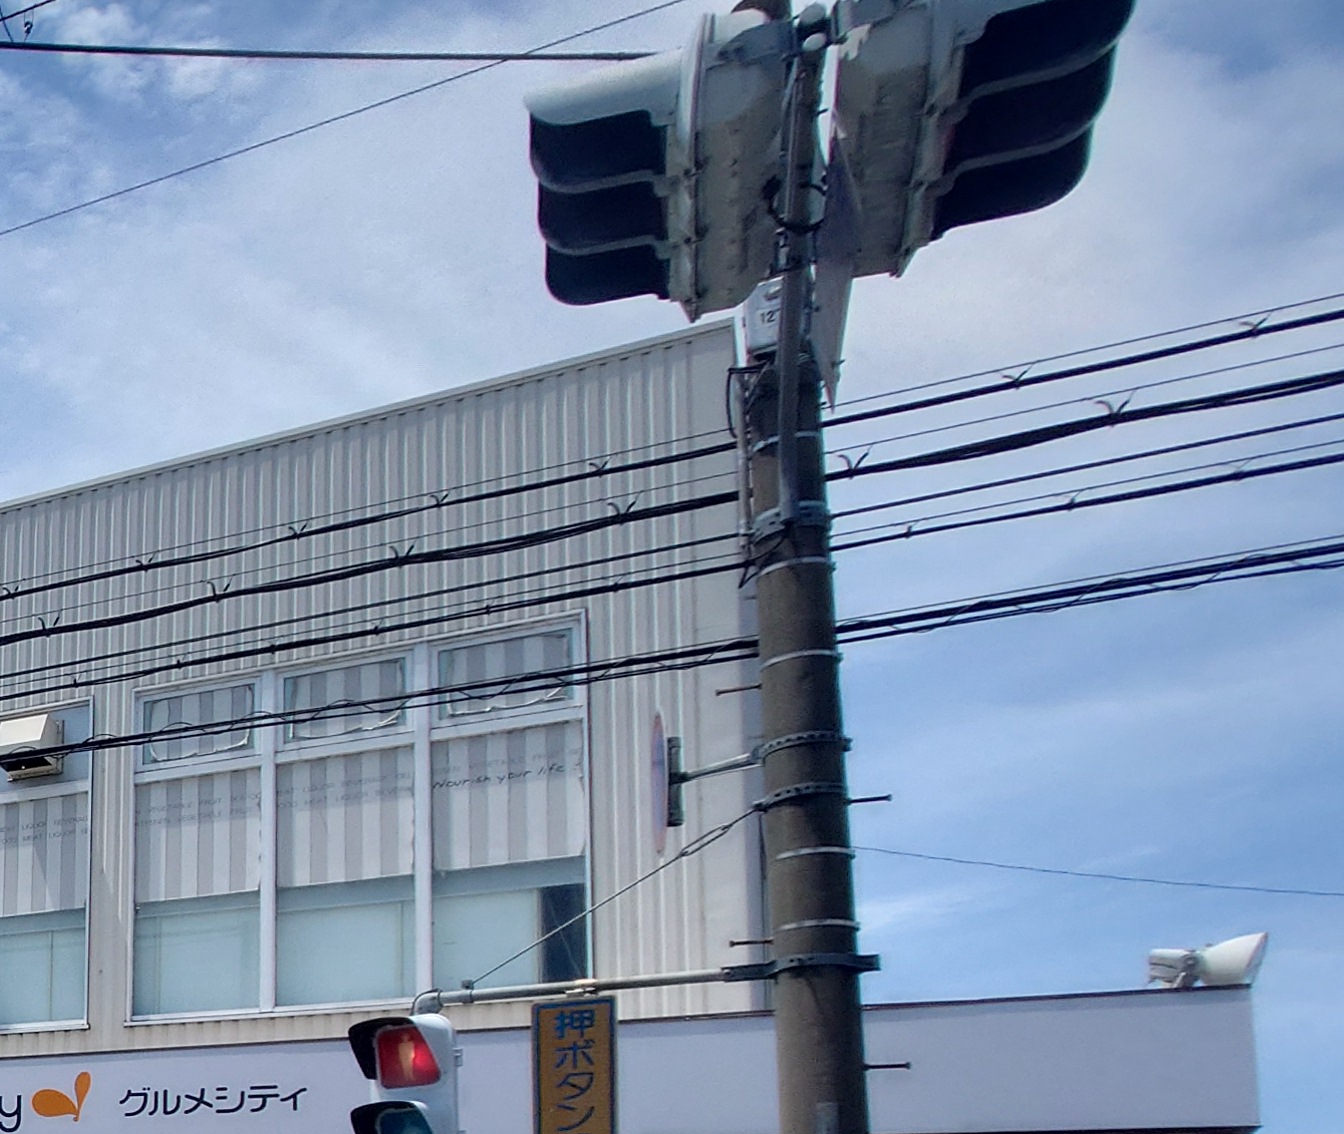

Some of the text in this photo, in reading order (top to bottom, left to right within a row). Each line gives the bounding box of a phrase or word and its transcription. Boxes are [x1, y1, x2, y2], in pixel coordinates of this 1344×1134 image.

[118, 1084, 308, 1118] グルメシティ
